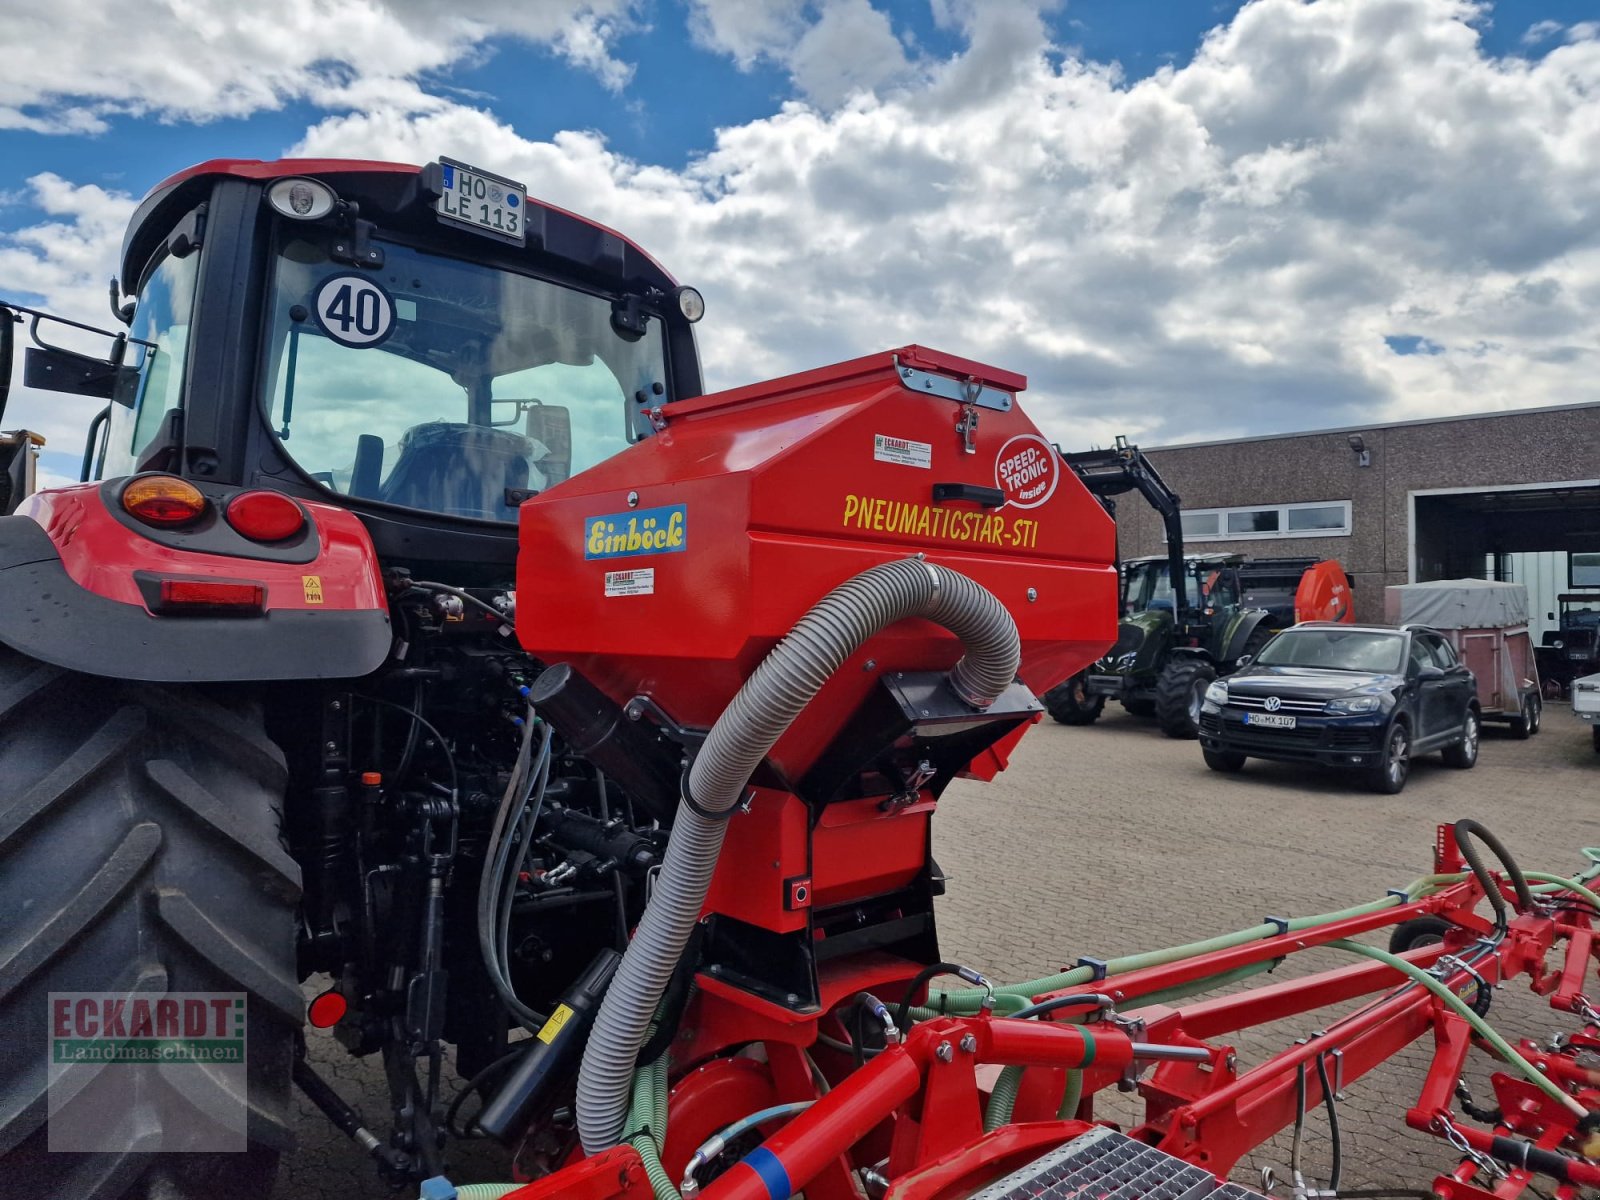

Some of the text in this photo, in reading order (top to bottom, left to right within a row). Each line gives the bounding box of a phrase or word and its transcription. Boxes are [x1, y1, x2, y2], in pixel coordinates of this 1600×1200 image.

[459, 172, 487, 199] HO
[444, 191, 519, 232] LE 113
[325, 284, 381, 336] 40
[999, 447, 1040, 479] SPEED-
[1005, 457, 1048, 492] TRONIC
[1019, 481, 1047, 499] inside
[588, 511, 683, 554] Einböck
[843, 494, 1039, 548] PNEUMATICSTAR-STI
[1278, 717, 1295, 726] 107
